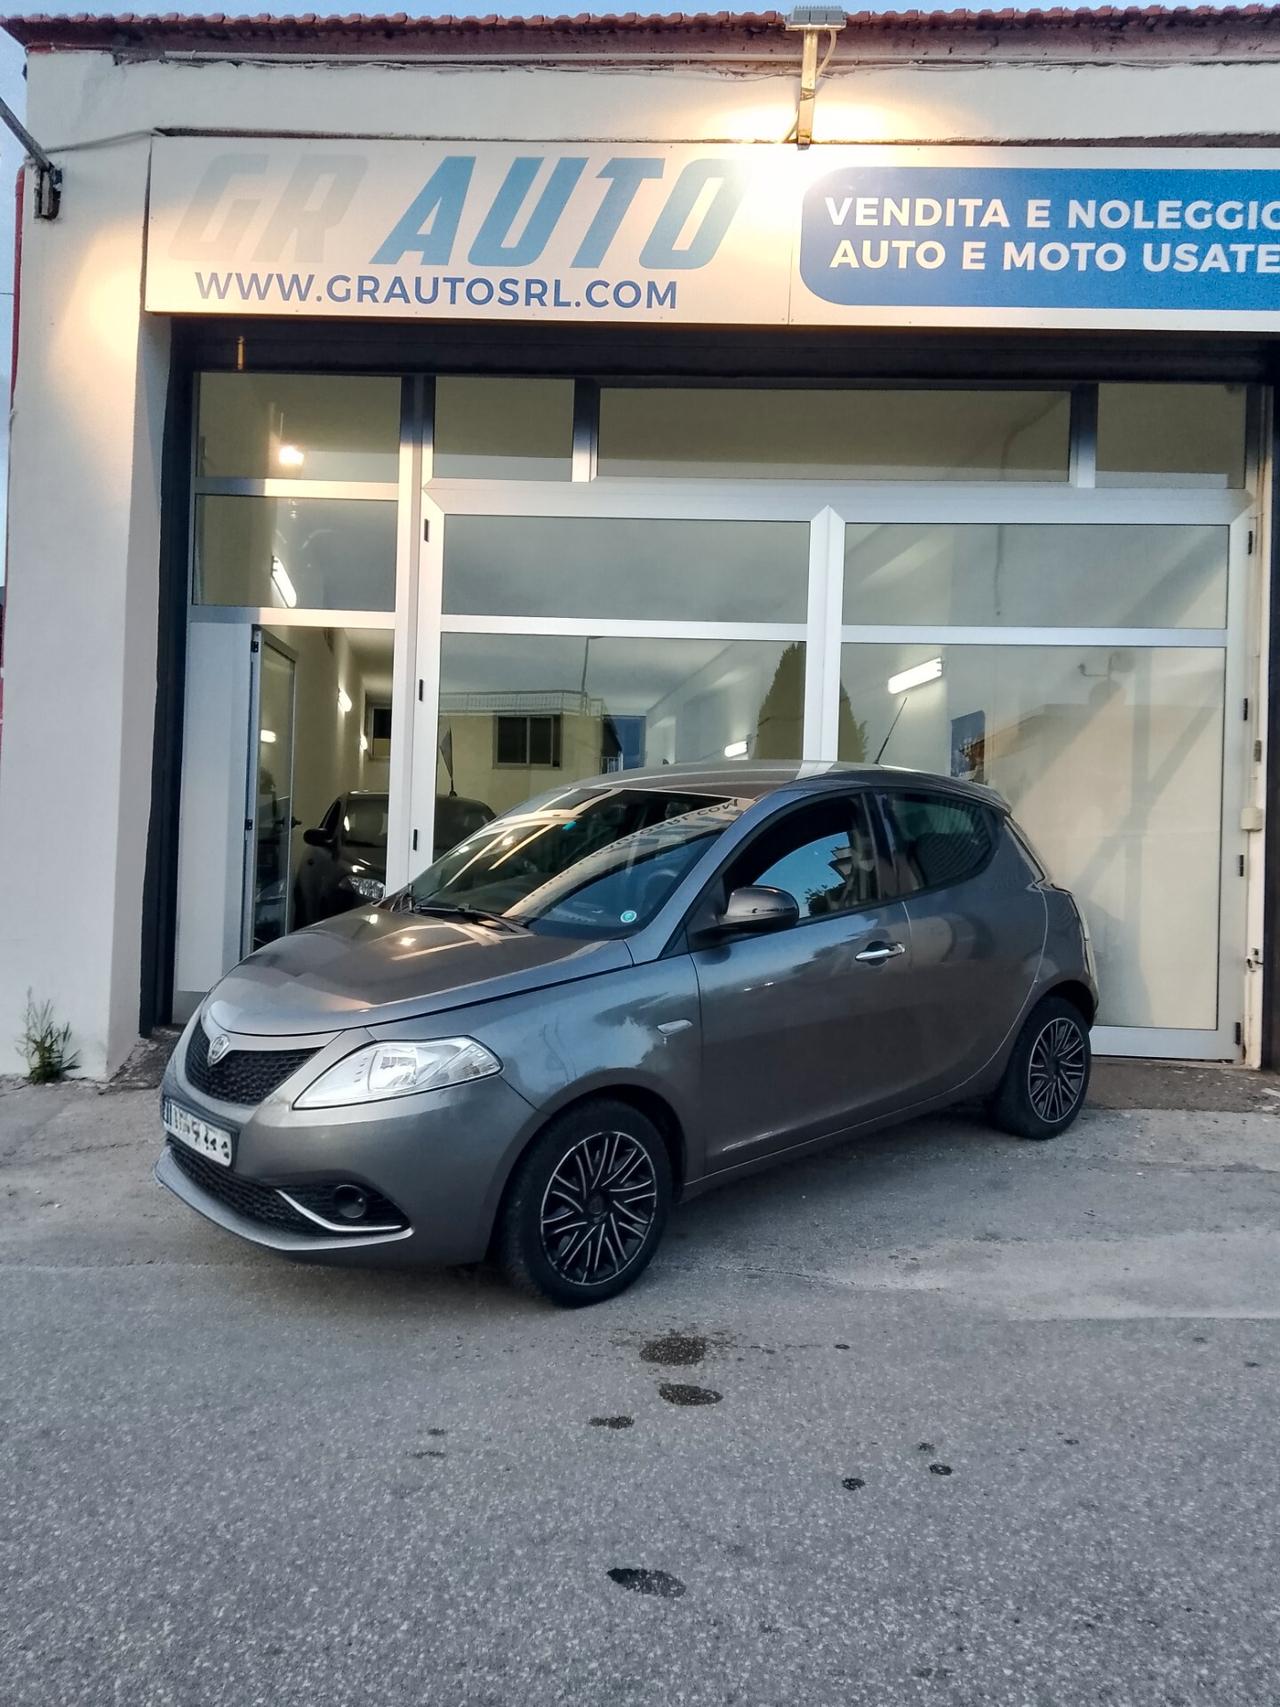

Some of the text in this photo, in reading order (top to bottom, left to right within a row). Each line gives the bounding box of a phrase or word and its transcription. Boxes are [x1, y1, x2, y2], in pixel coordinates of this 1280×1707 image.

[168, 153, 746, 270] GR AUTO
[825, 197, 1010, 228] VENDITA
[1027, 200, 1051, 228] E
[829, 240, 1280, 274] AUTO E MOTO USATE
[195, 271, 678, 310] WWW.GRAUTOSRL.COM
